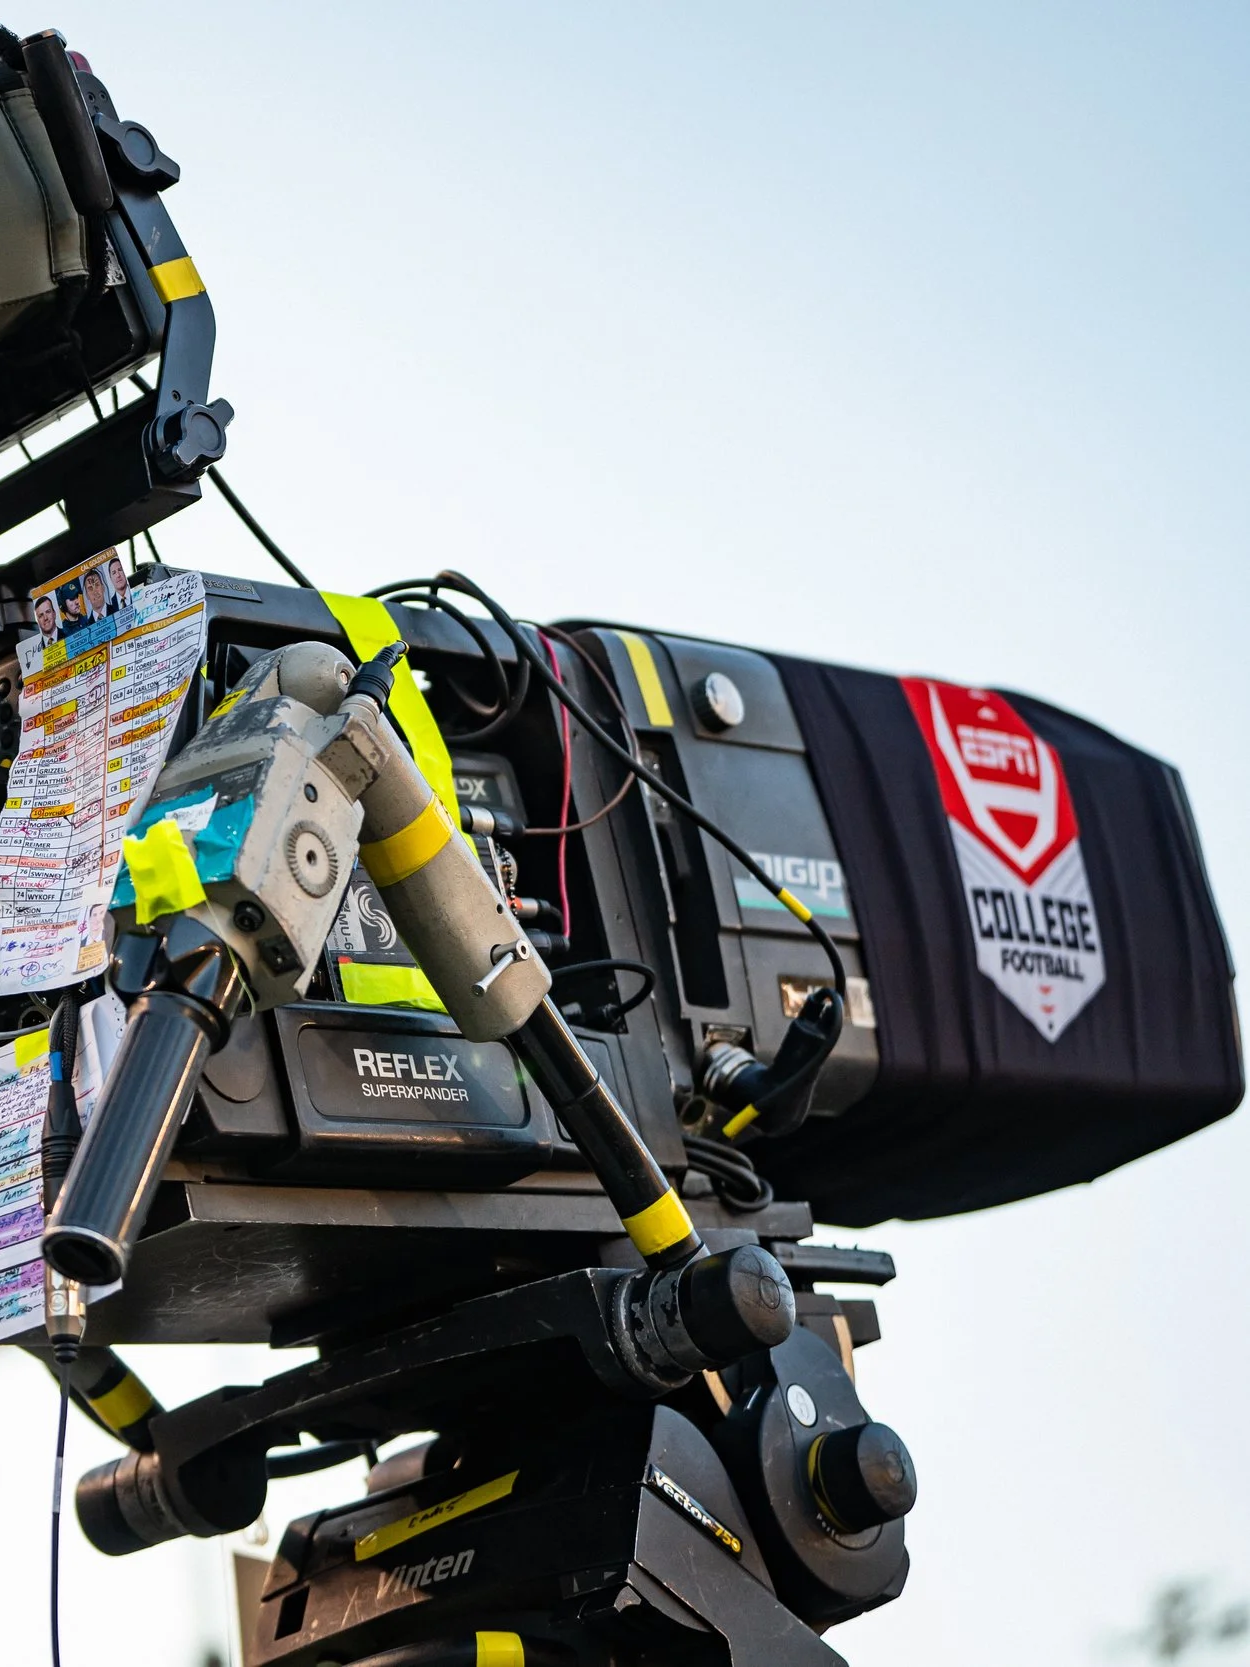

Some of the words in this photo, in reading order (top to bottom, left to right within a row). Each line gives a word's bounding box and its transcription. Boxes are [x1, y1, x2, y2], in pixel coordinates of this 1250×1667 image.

[956, 724, 1039, 779] ESPN
[30, 871, 63, 879] SWINNEY
[971, 887, 1097, 953] COLLEGE
[1001, 948, 1085, 982] FOOTBALL
[353, 1048, 464, 1082] REFLEX
[361, 1083, 470, 1102] SUPERXPANDER
[376, 1548, 476, 1601] Vinten
